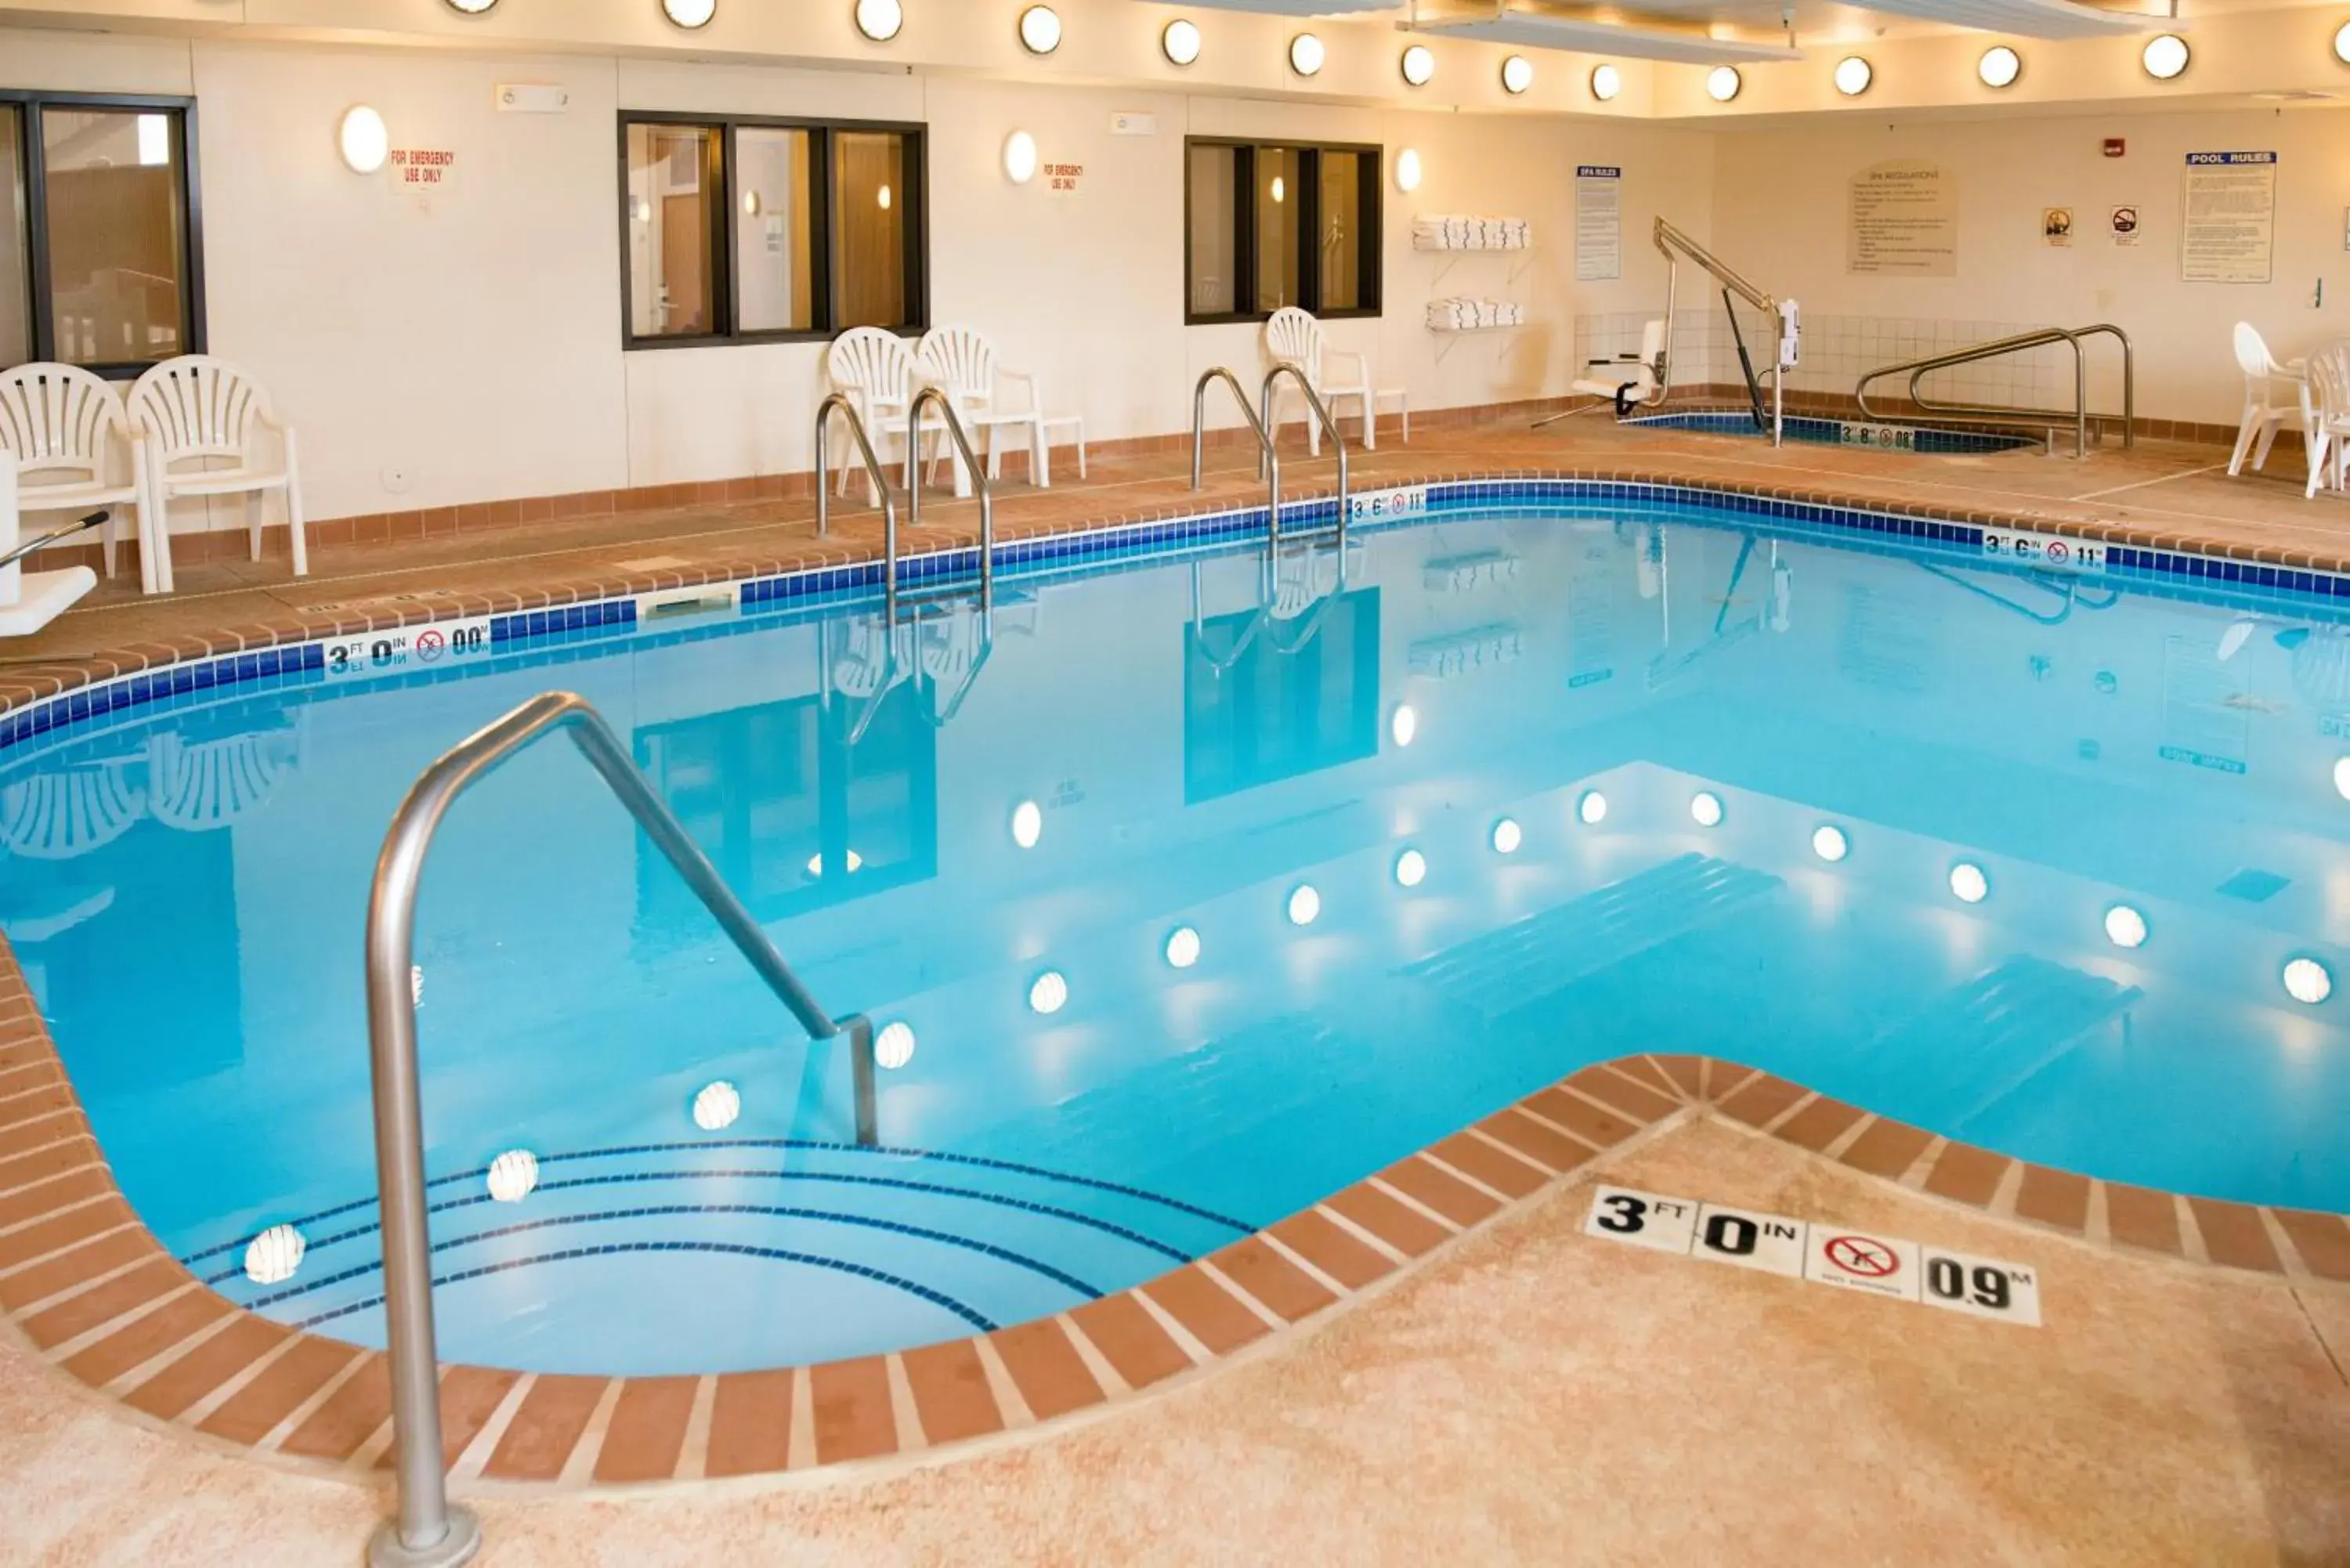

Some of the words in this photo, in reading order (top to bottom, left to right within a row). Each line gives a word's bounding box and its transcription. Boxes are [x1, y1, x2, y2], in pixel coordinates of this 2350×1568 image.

[391, 150, 407, 165] FOR
[410, 150, 454, 167] EMERGENCY
[2191, 154, 2225, 164] POOL
[2230, 153, 2270, 163] RULES
[404, 167, 419, 182] USE
[423, 167, 442, 182] ONLY
[330, 645, 348, 674] 3
[350, 642, 363, 654] FT
[392, 637, 406, 649] IN
[1597, 1195, 1647, 1234] 3
[1654, 1201, 1687, 1219] FT
[1704, 1214, 1758, 1256] 0
[1763, 1223, 1796, 1240] IN
[2011, 1270, 2032, 1285] M
